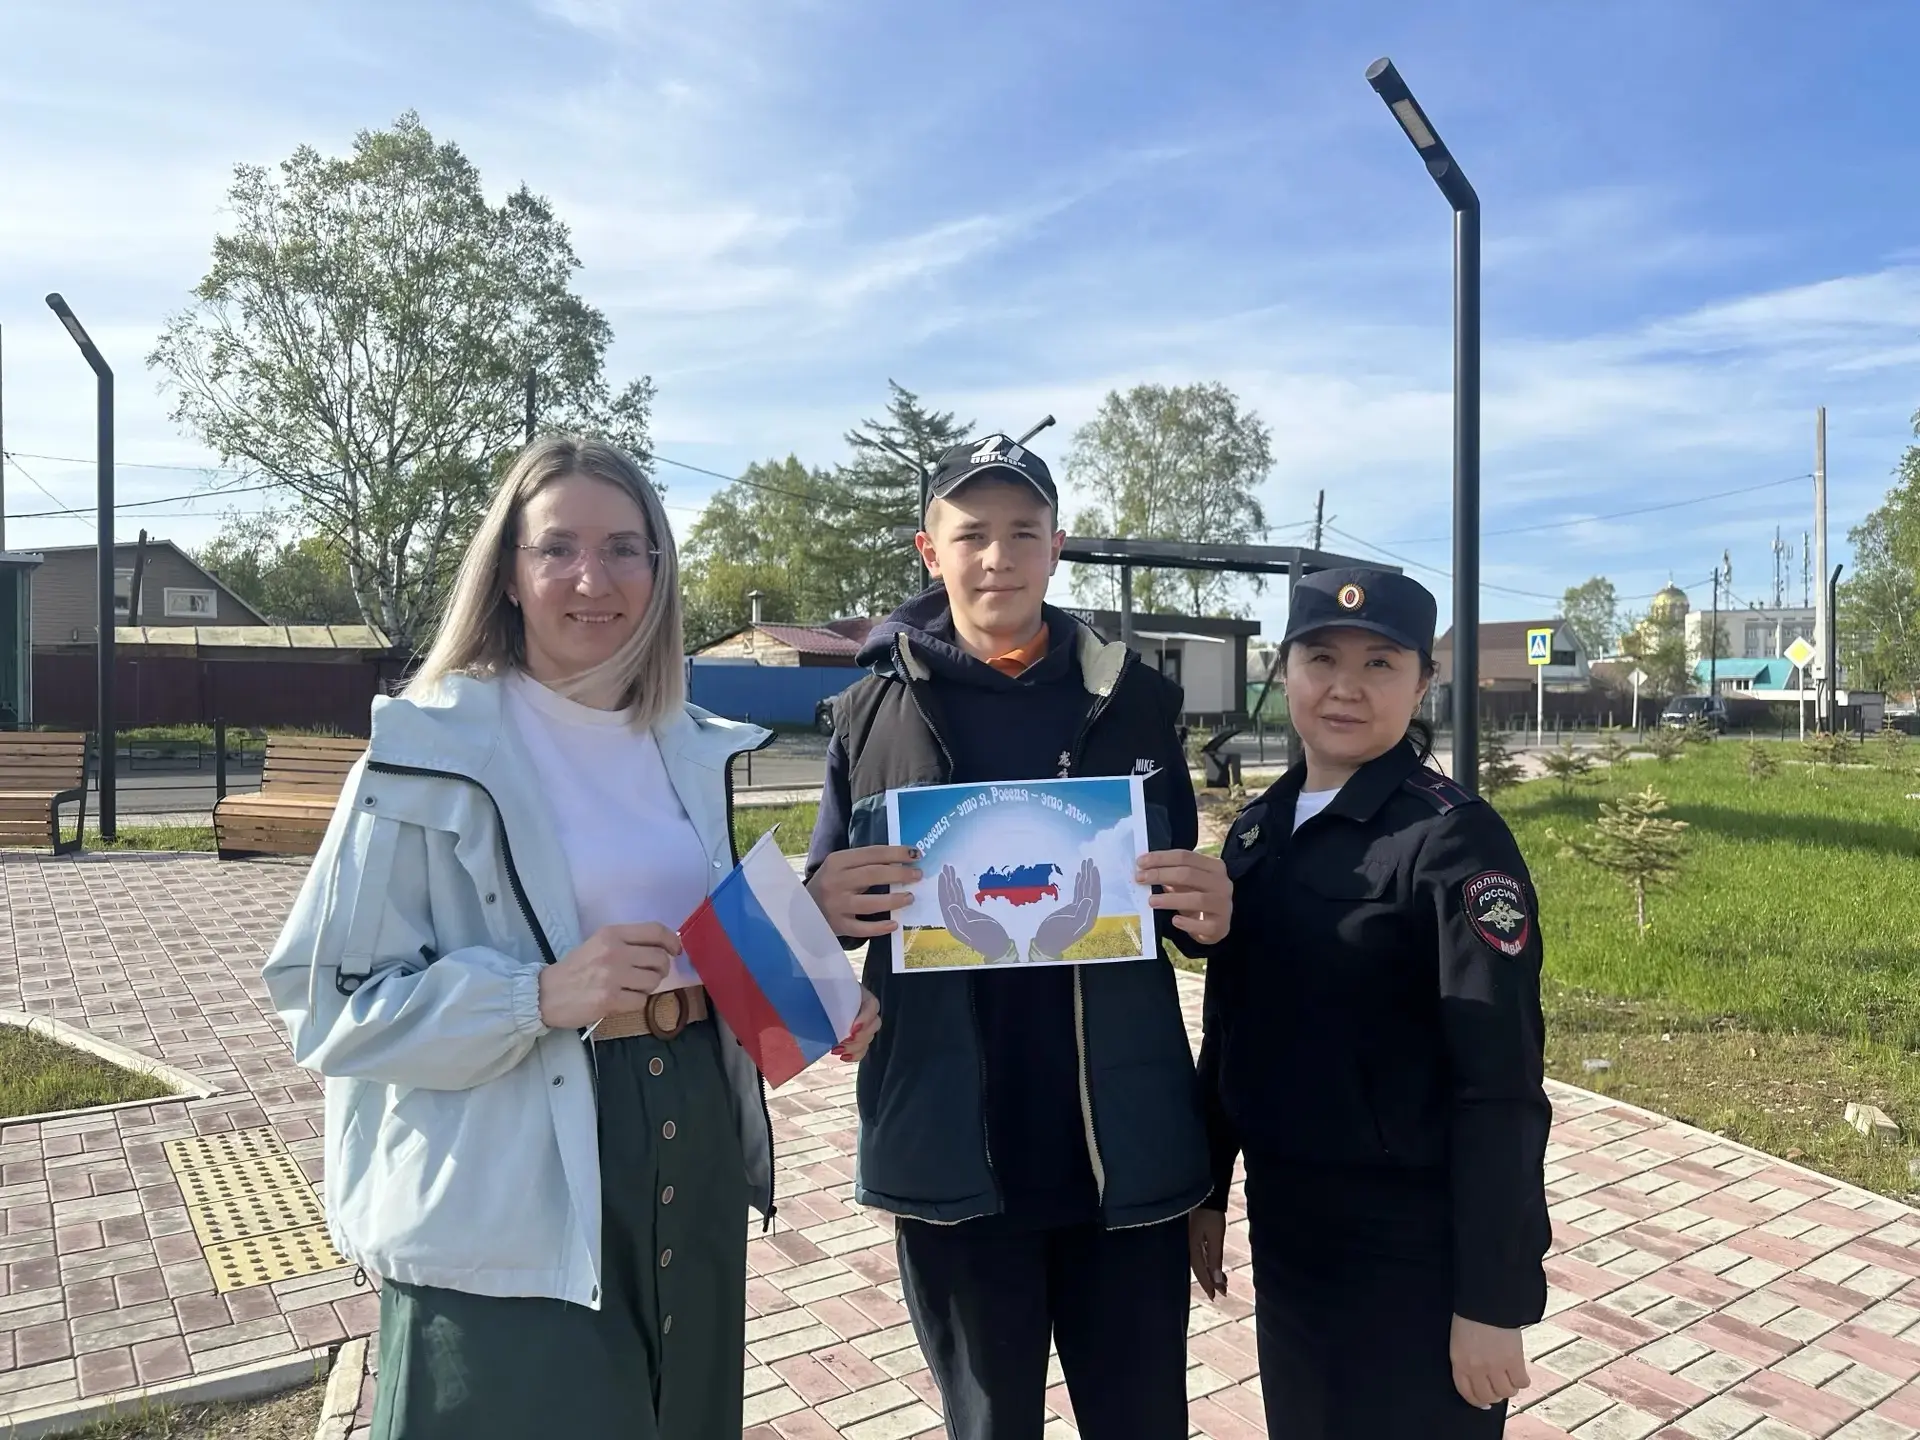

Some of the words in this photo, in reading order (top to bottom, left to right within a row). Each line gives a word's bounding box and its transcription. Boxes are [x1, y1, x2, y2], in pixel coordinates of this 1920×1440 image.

[1135, 758, 1155, 772] NIKE
[957, 797, 978, 816] это
[990, 786, 1028, 803] Россия
[1041, 792, 1063, 811] это
[1470, 875, 1519, 896] ПОЛИЦИЯ
[1479, 889, 1517, 906] РОССИЯ
[1500, 940, 1521, 956] МВД
